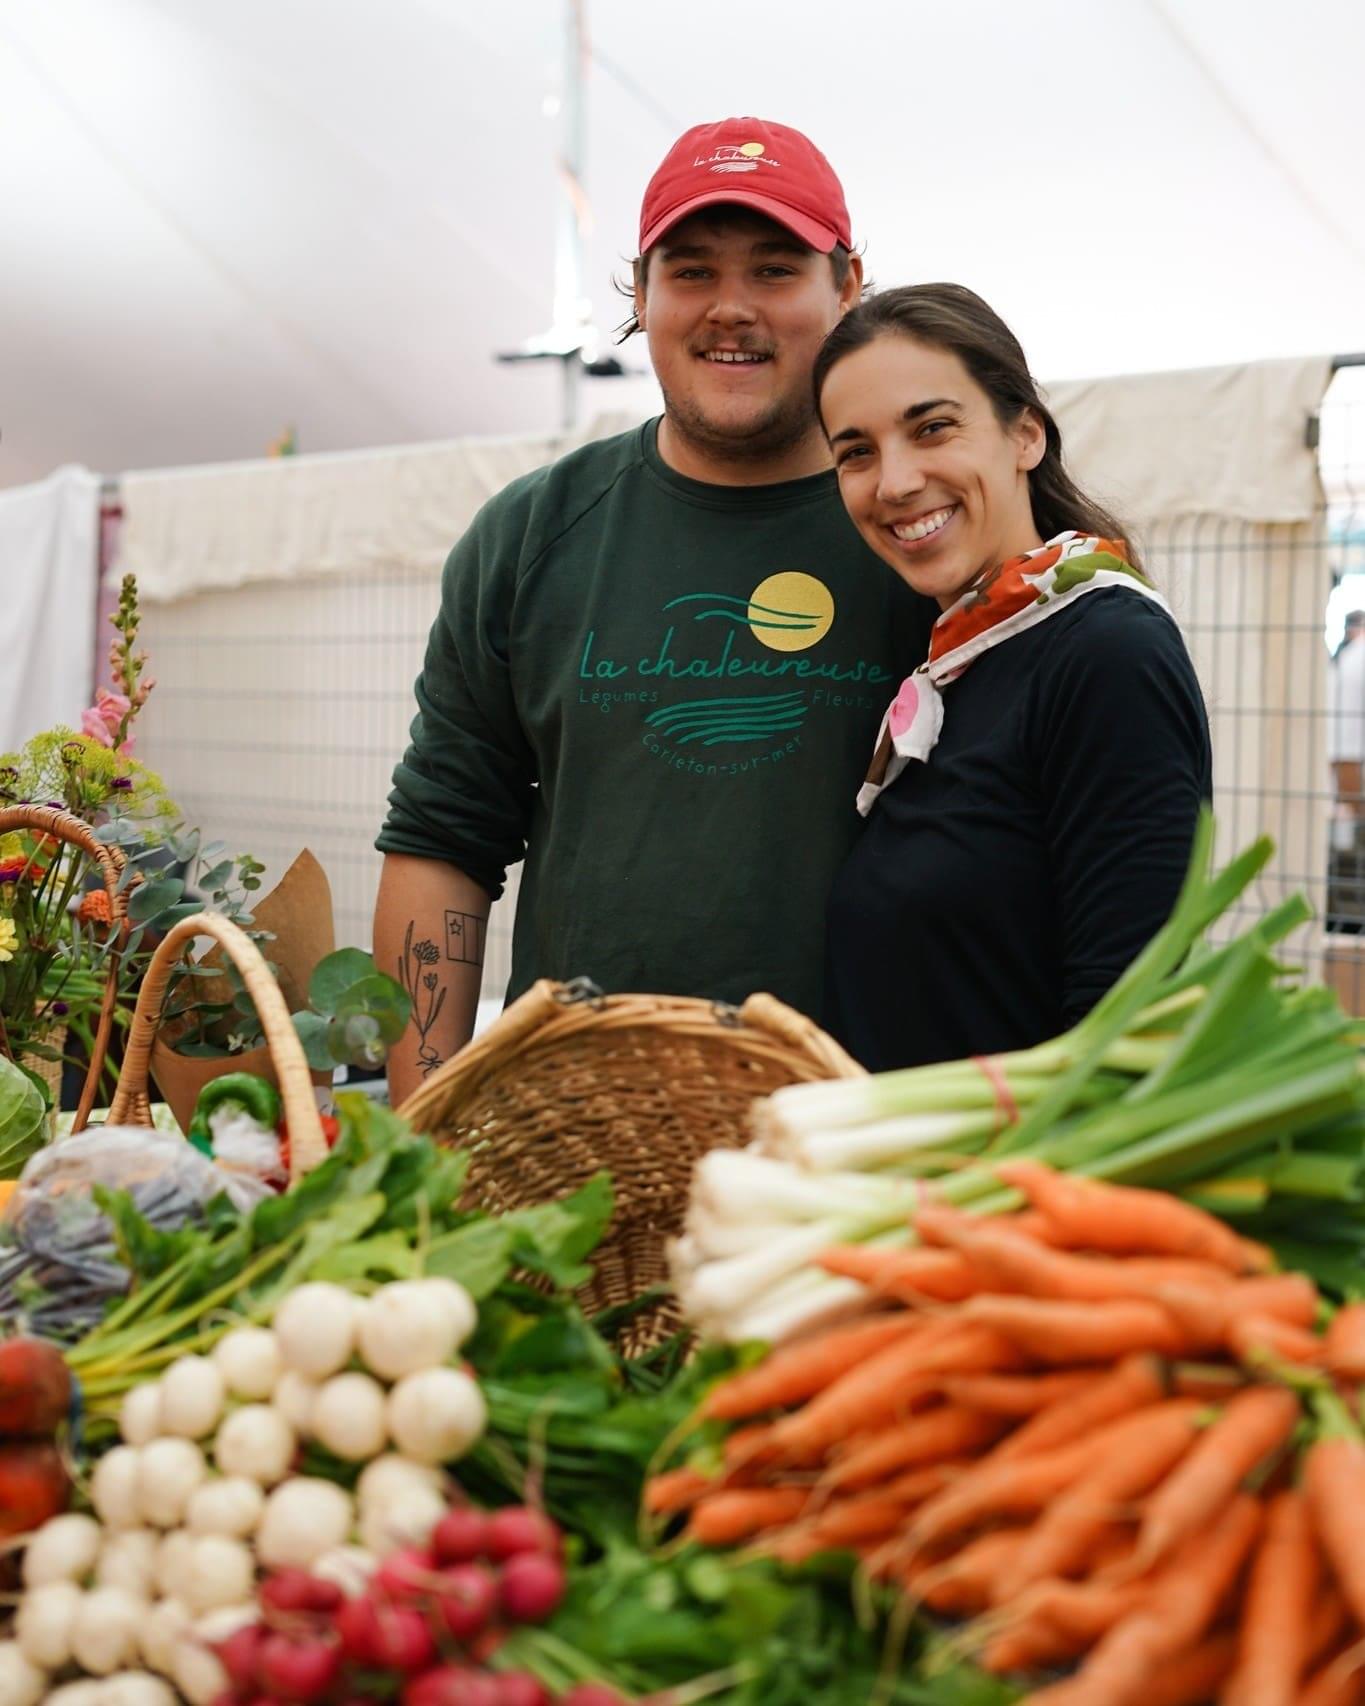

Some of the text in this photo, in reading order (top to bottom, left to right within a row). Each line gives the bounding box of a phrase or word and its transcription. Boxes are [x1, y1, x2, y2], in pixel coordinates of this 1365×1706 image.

[579, 626, 893, 681] La chaleureuse
[579, 688, 658, 713] Légumes
[812, 689, 874, 709] Fleurs
[642, 733, 804, 776] Carleton-sur-mer
